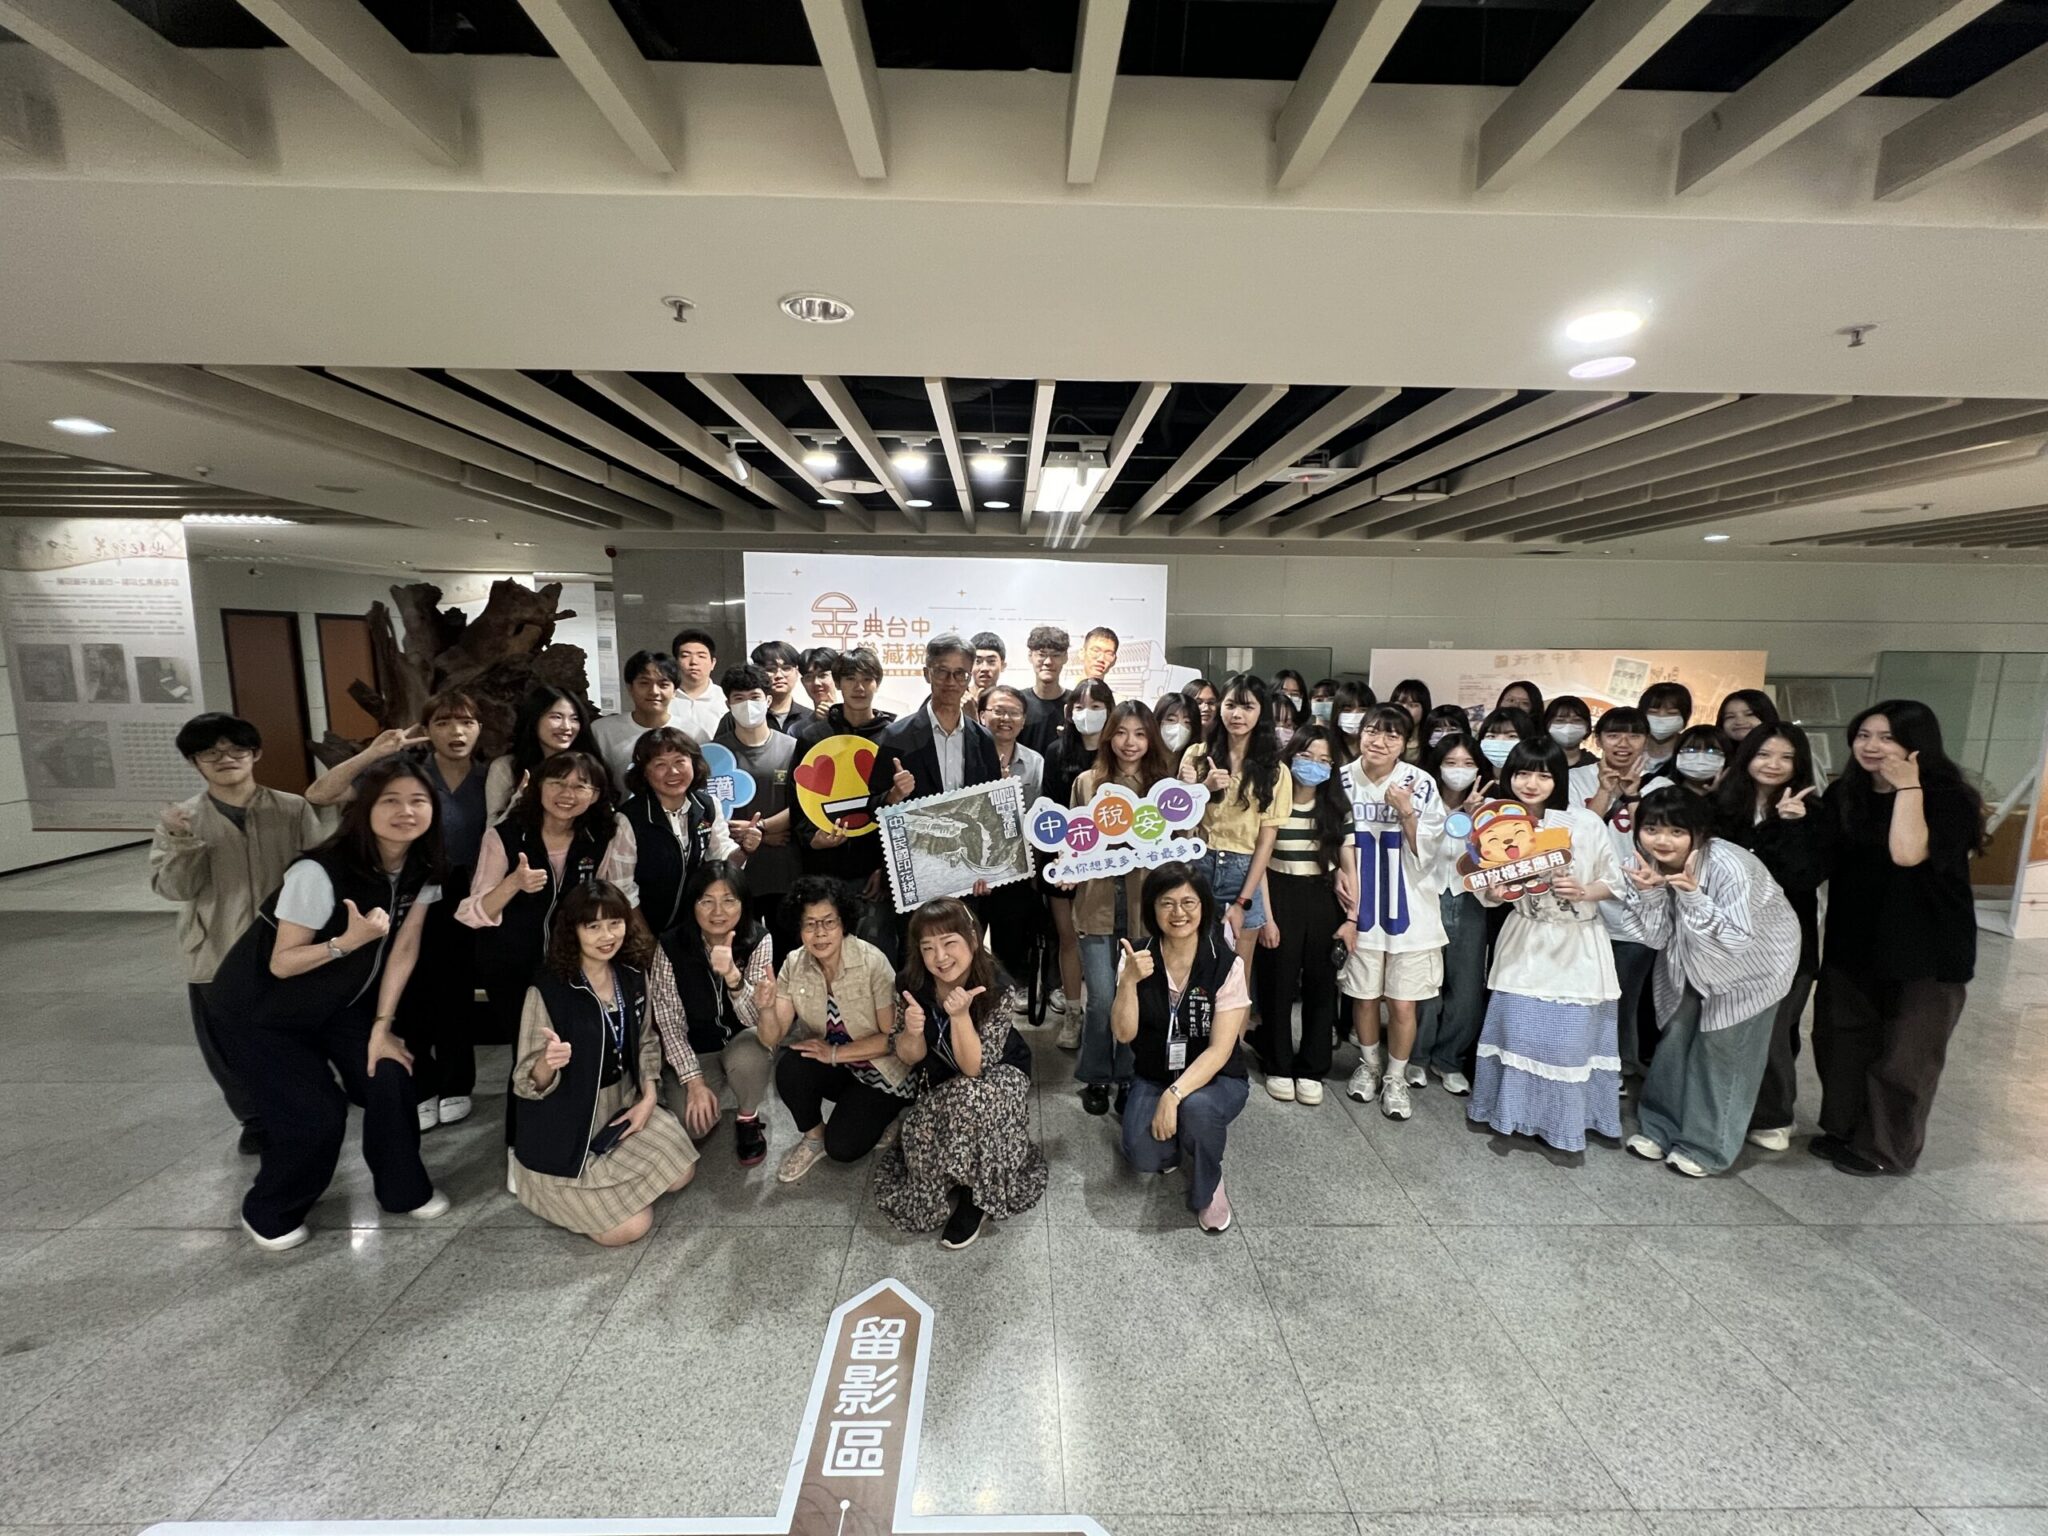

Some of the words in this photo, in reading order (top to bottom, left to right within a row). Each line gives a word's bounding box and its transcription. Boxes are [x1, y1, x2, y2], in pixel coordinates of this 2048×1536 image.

[1039, 795, 1190, 847] 中市稅安心
[1470, 851, 1565, 889] 開放檔案應用
[822, 1315, 907, 1477] 留影區
